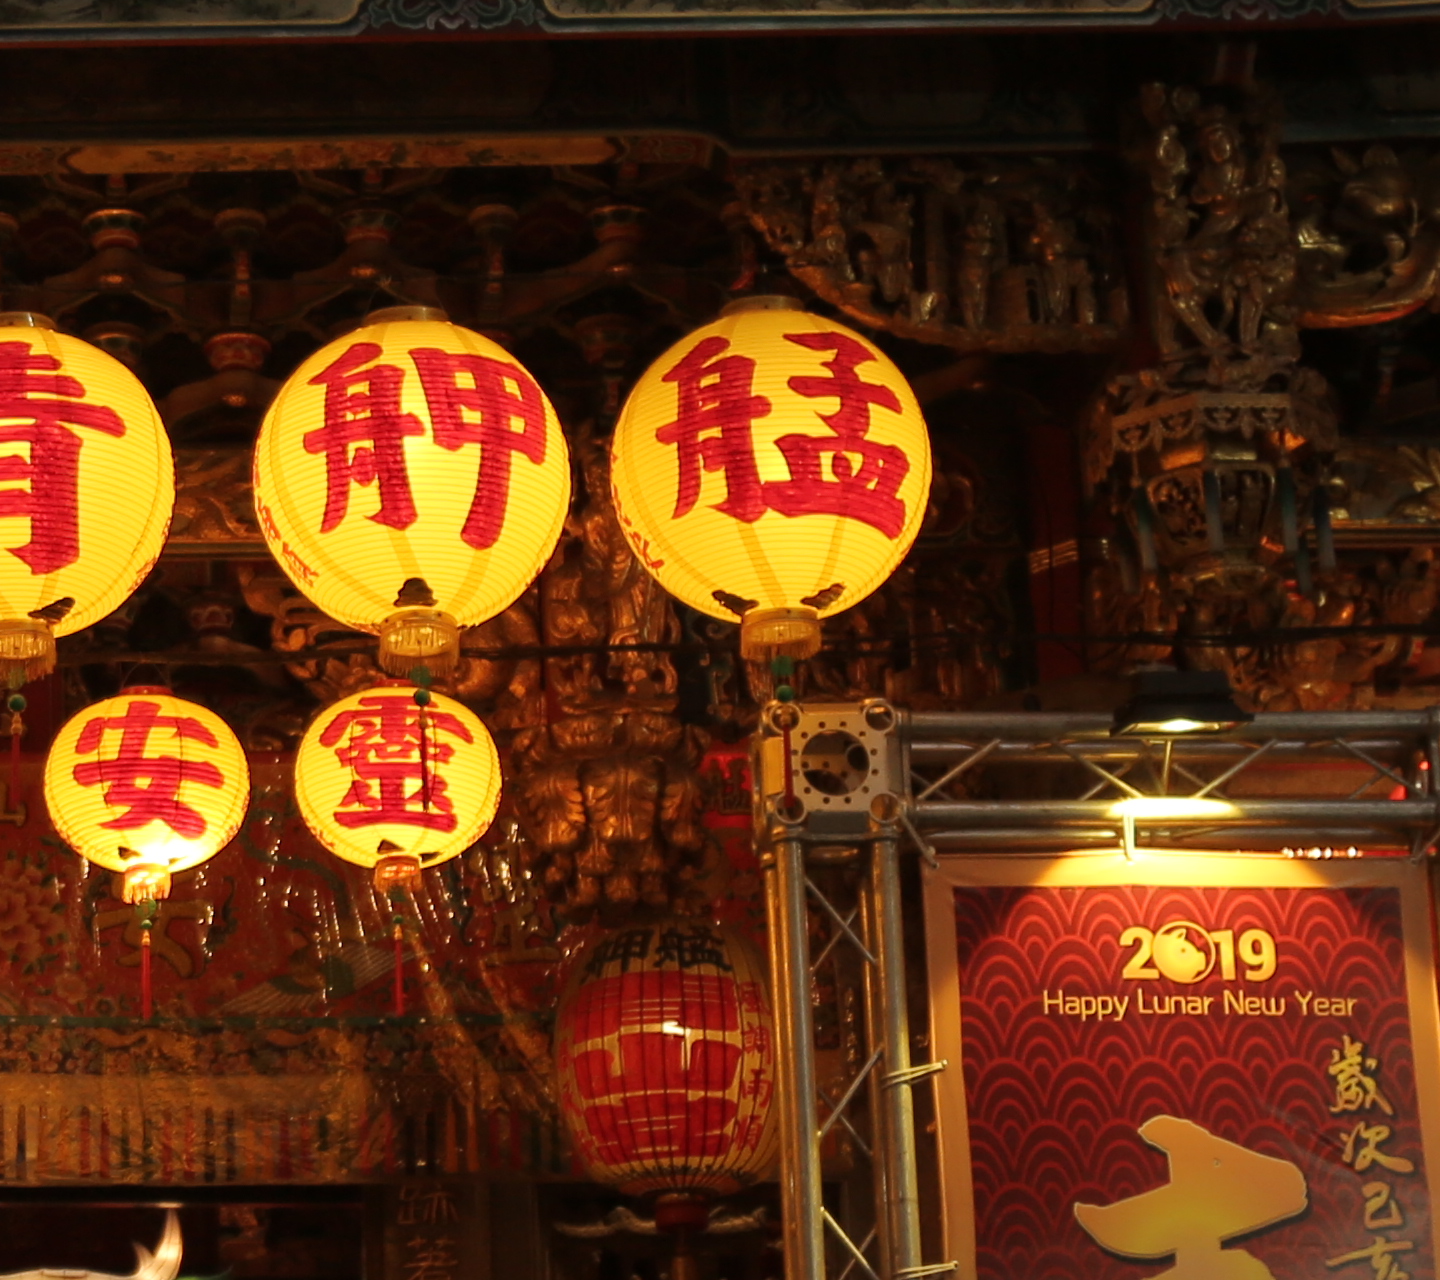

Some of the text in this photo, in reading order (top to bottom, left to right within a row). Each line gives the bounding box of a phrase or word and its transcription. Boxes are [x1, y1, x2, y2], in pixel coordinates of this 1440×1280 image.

[1120, 920, 1278, 984] 2019
[1043, 988, 1358, 1021] Happy Lunar New Year
